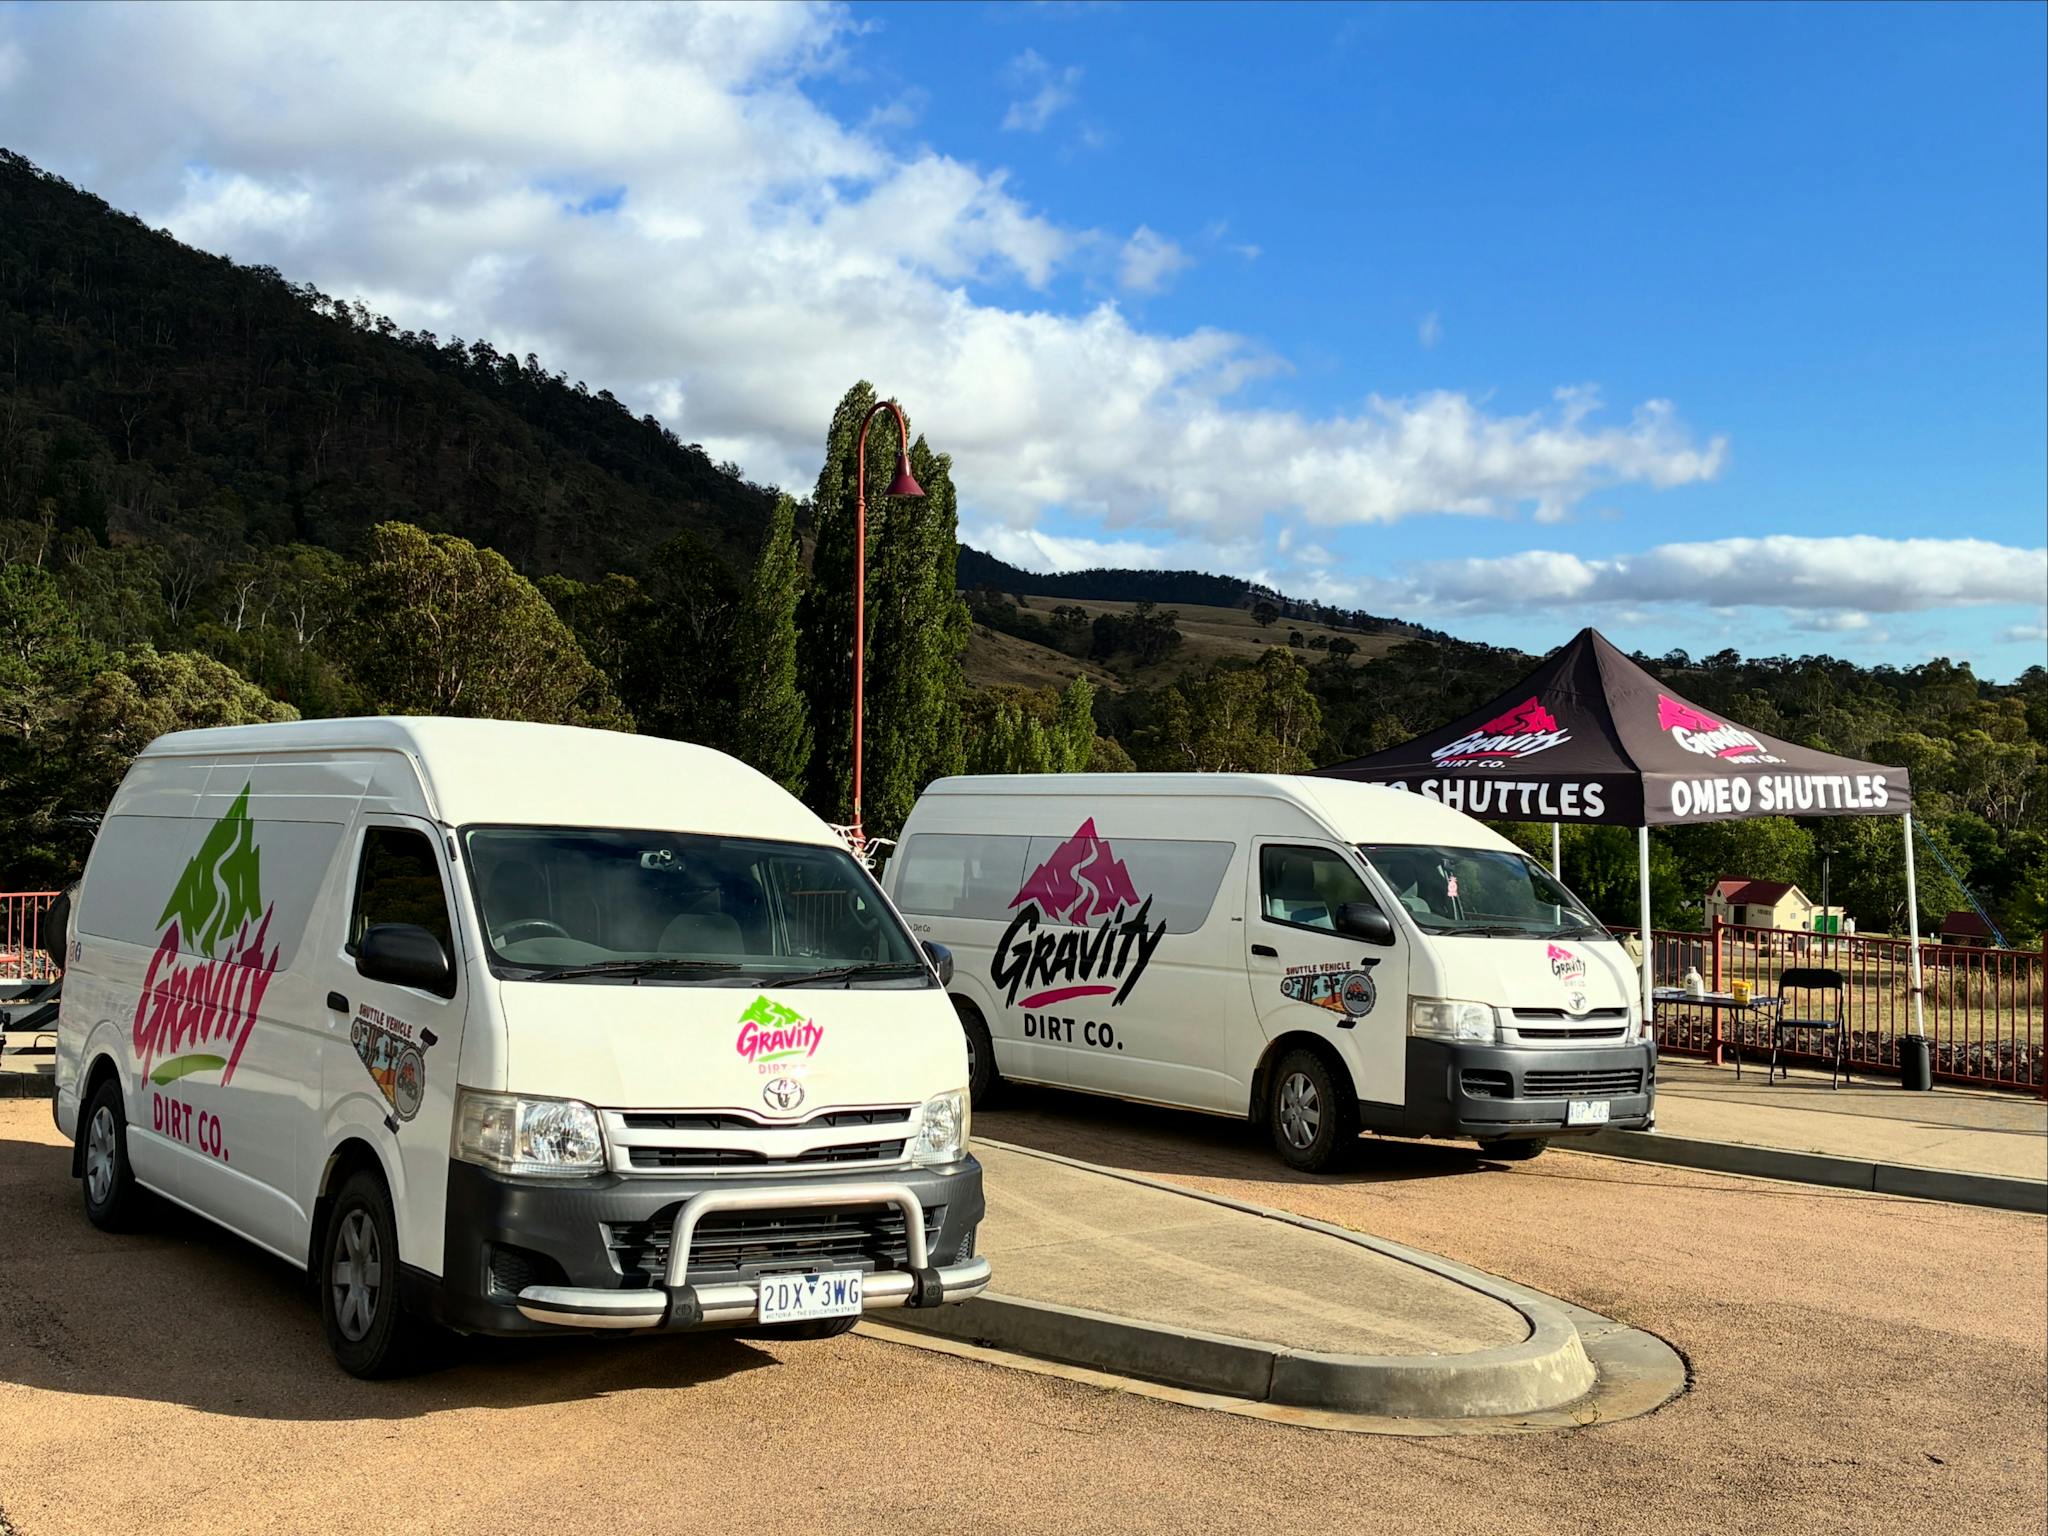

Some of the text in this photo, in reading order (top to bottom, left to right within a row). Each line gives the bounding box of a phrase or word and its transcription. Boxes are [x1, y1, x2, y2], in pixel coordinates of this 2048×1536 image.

[1436, 759, 1506, 768] DIRT CO.
[1421, 779, 1606, 817] SHUTTLES
[1671, 775, 1889, 817] OMEO SHUTTLES
[1286, 961, 1351, 975] SHUTTLE VEHICLE
[359, 1002, 413, 1039] SHUTTLE VEHICLE
[1024, 1013, 1123, 1050] DIRT CO.
[153, 1092, 229, 1161] DIRT CO.
[765, 1278, 858, 1311] 2DX 3WG
